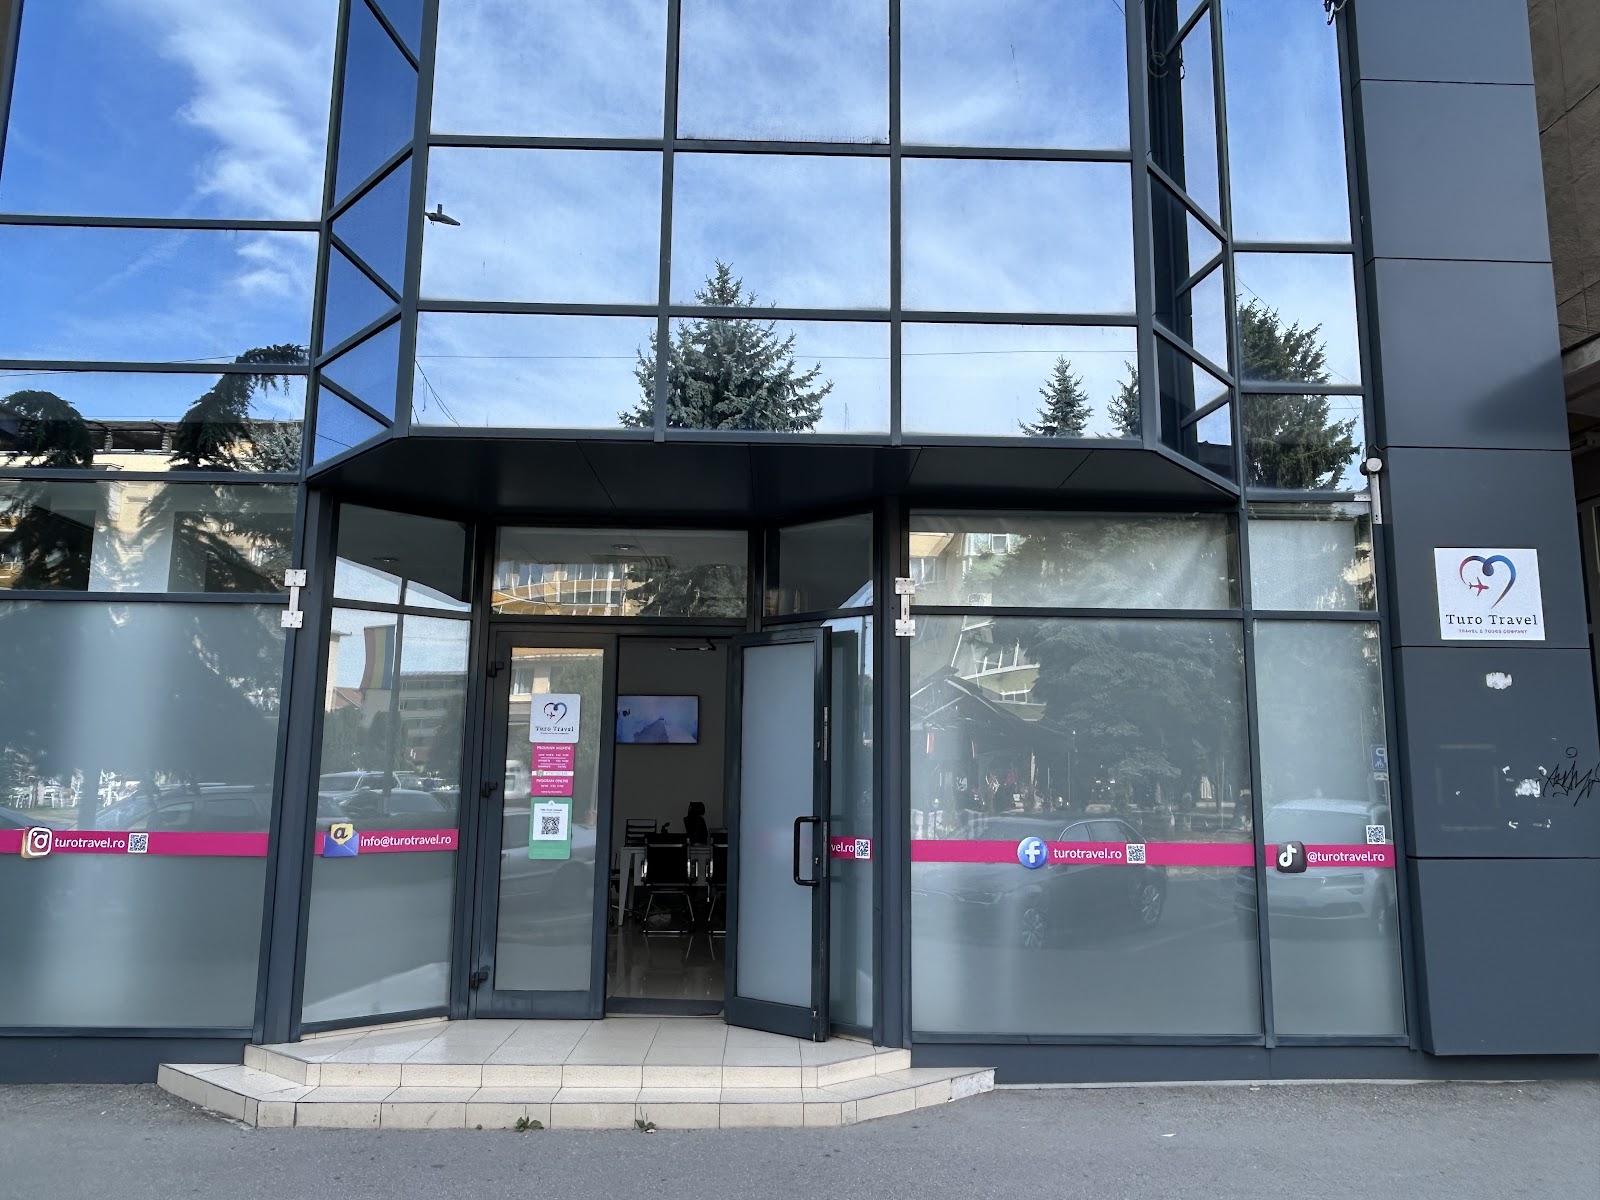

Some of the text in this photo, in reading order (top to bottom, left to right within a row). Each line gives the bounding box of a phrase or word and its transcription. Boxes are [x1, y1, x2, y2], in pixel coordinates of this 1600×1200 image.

[1445, 614, 1539, 625] Turo Travel
[54, 837, 125, 848] turotravel.ro
[360, 834, 452, 847] info@turotravel.ro
[1053, 848, 1122, 859] turotravel.ro
[1307, 851, 1385, 863] @turotravel.ro
